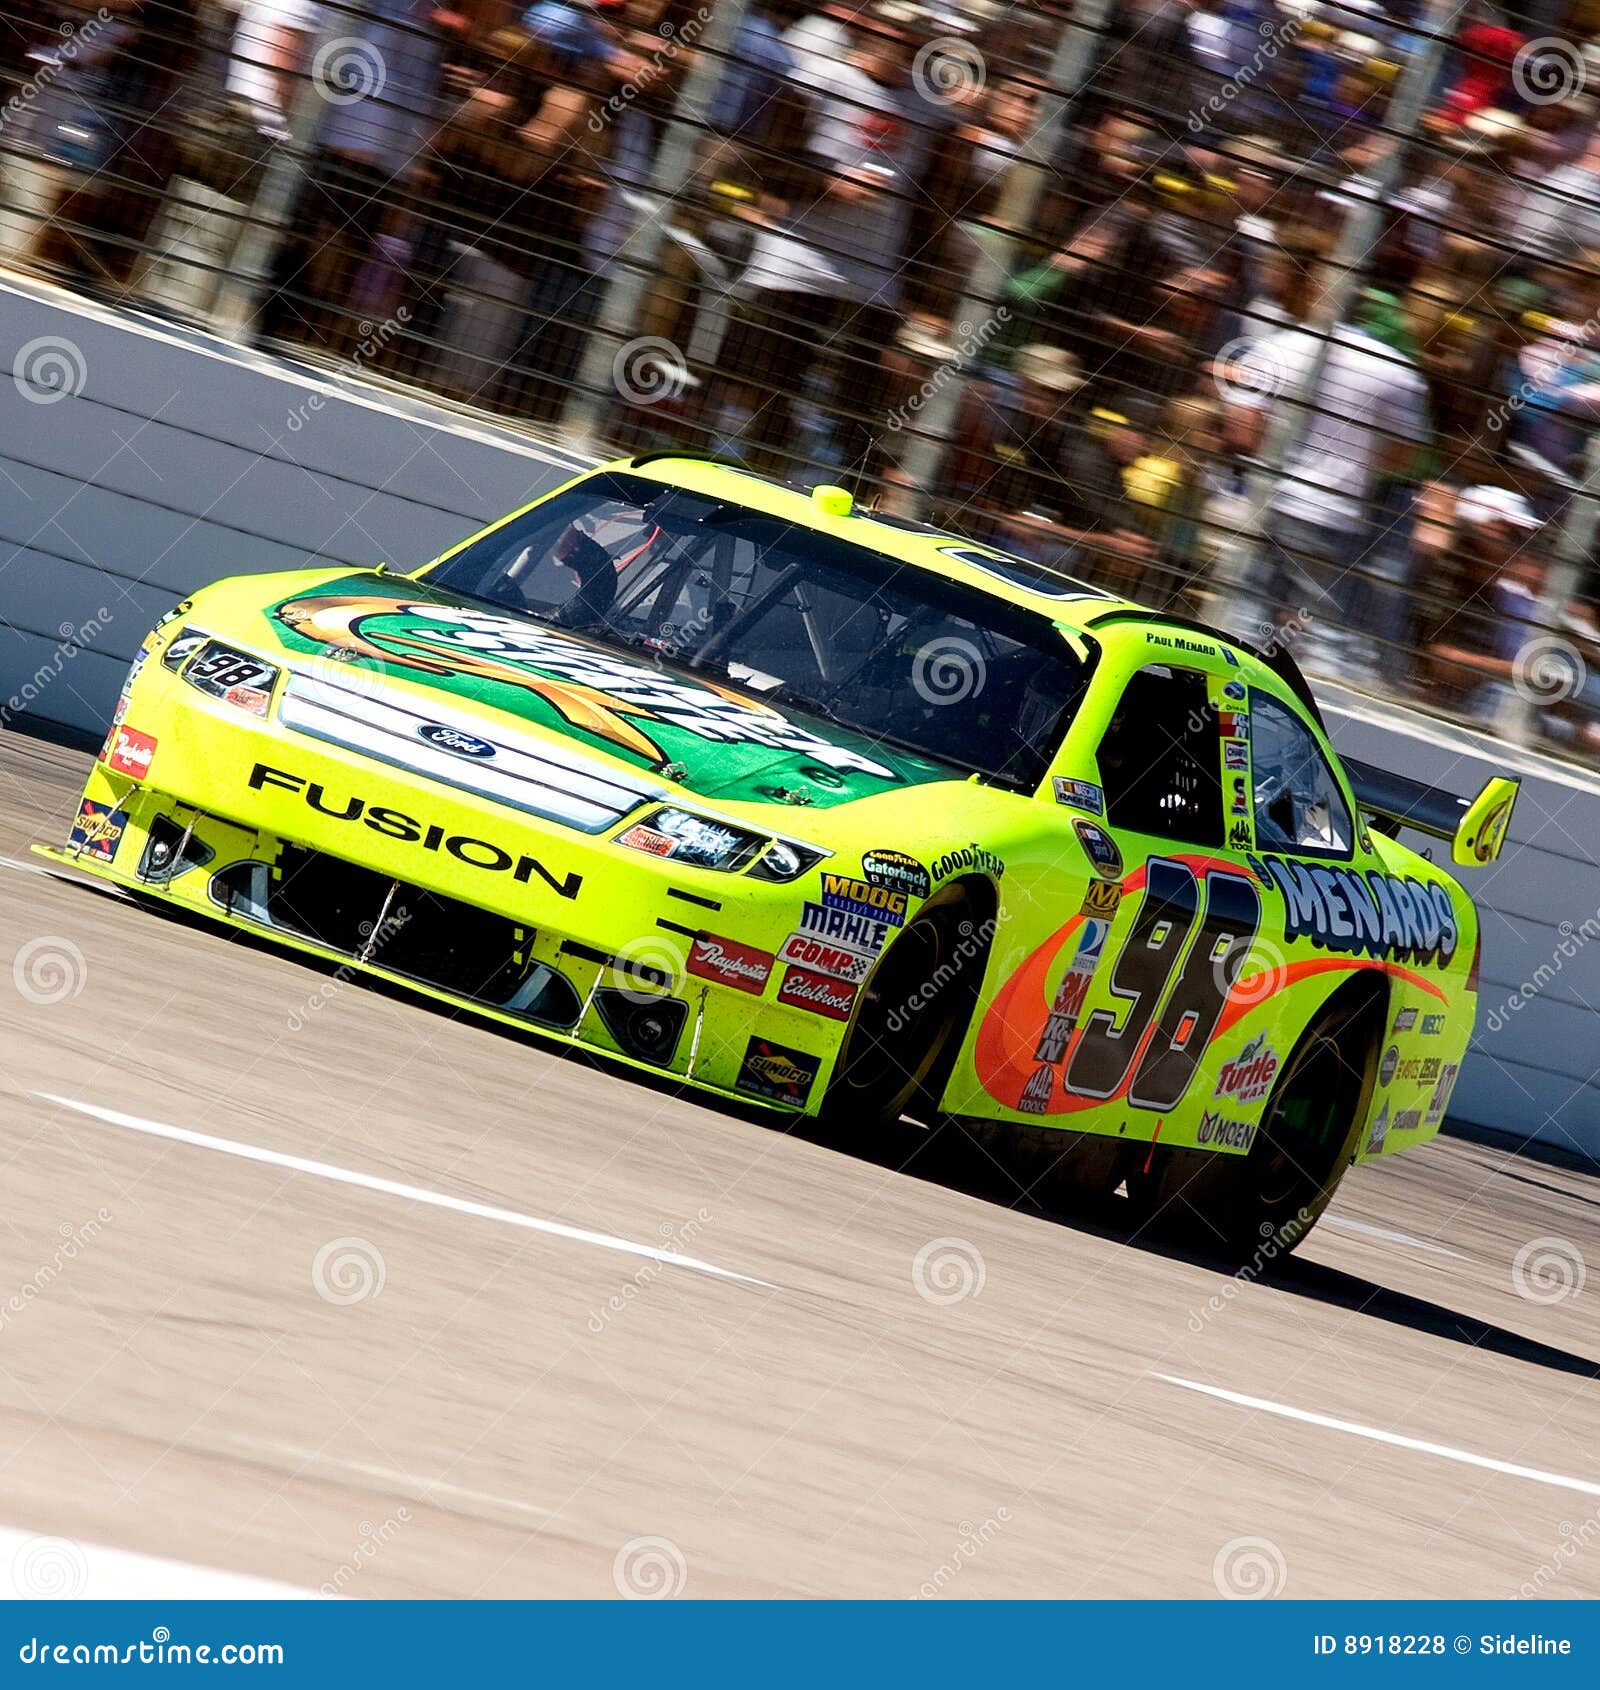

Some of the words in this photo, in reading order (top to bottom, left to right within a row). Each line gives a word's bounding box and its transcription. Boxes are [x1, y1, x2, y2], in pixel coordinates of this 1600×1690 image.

[1147, 633, 1171, 648] PAUL
[1174, 637, 1215, 656] MENARD
[190, 654, 265, 687] 98
[410, 628, 746, 742] STATE
[431, 728, 482, 754] Ford
[248, 763, 583, 900] FUSION
[863, 857, 928, 887] Gatorback
[871, 874, 925, 897] BELTS
[824, 875, 907, 915] MOOG
[1264, 856, 1458, 962] MENARDS
[801, 902, 889, 951] MAHLE
[786, 938, 854, 970] COMP
[783, 976, 850, 1012] Edelbrock
[1064, 854, 1262, 1114] 98
[751, 1057, 812, 1084] SUNOCO
[1215, 1050, 1277, 1095] Turtle
[1018, 1098, 1048, 1114] TOOLS
[1239, 1084, 1267, 1100] WAX
[1213, 1118, 1255, 1149] MOEN
